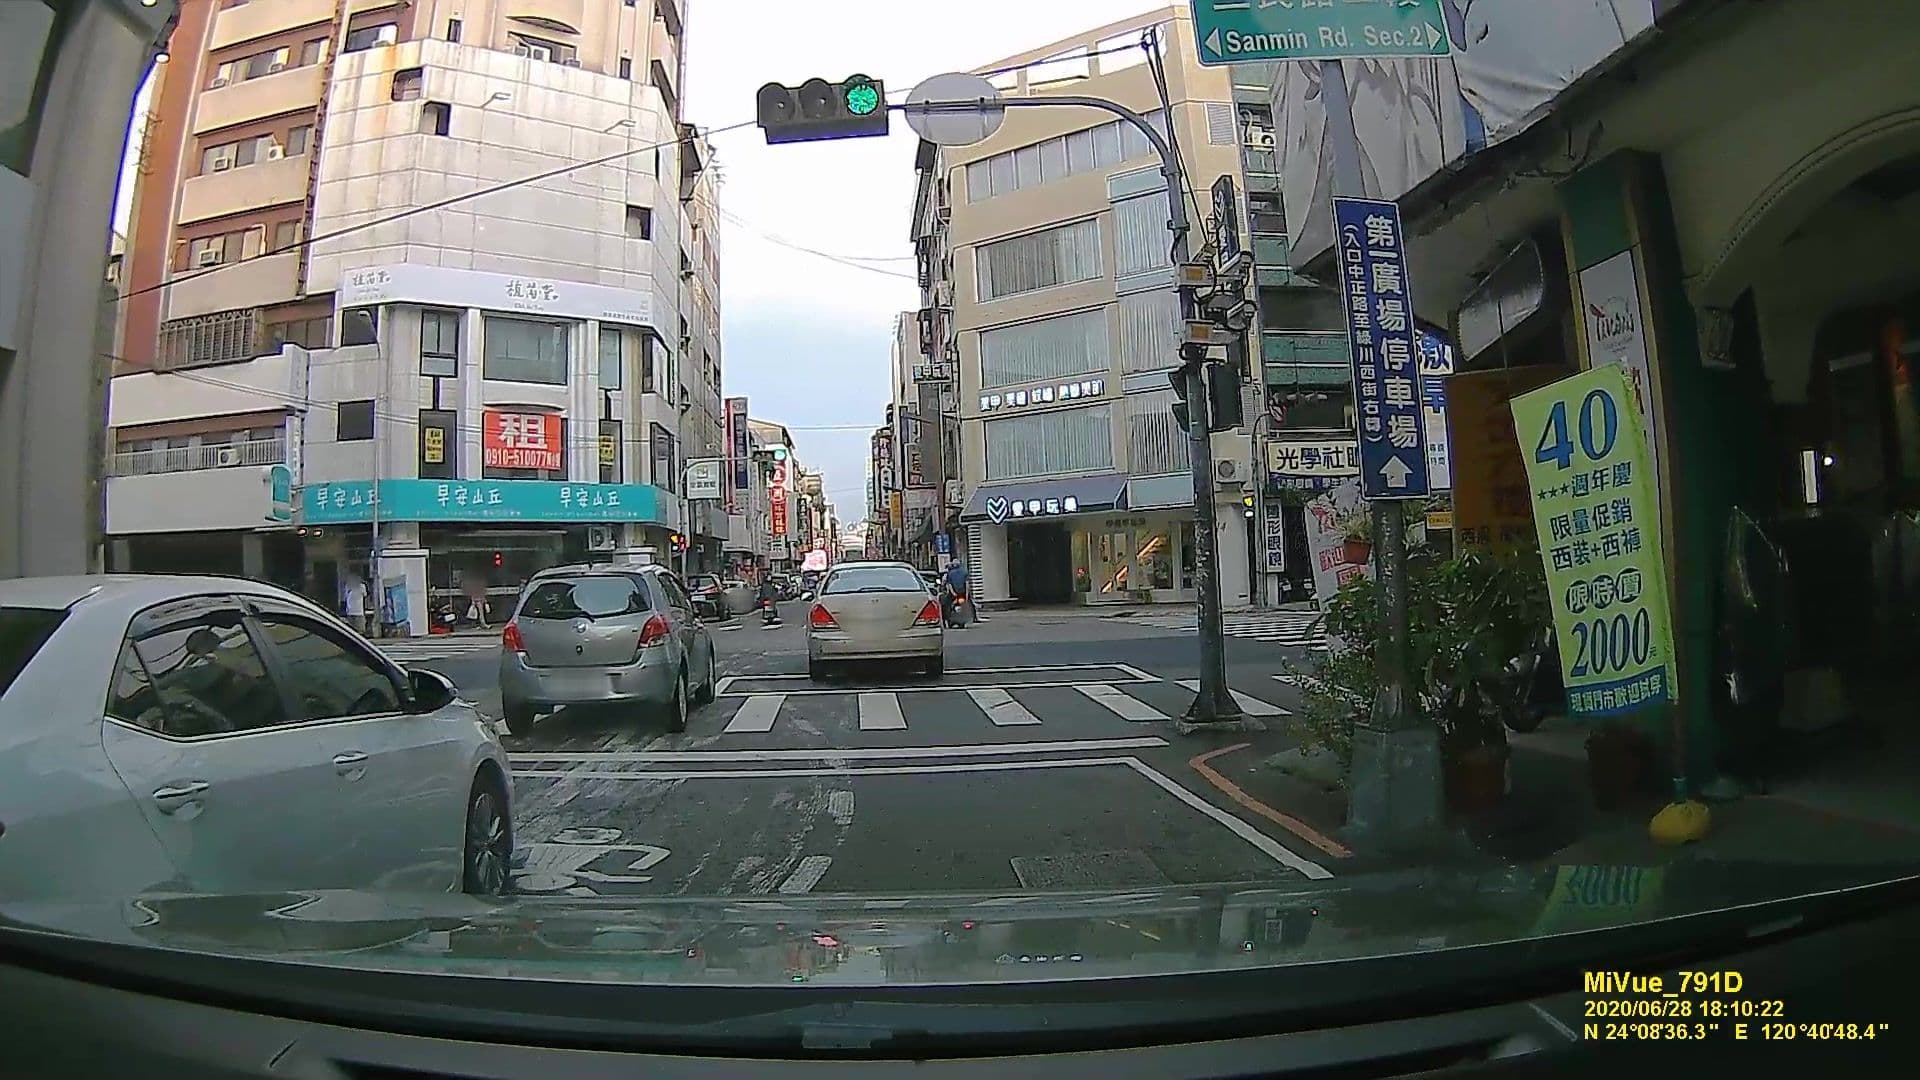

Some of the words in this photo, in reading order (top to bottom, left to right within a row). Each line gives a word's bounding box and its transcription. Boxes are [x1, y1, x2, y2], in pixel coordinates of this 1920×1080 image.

[1226, 28, 1307, 52] Sanmin
[1317, 27, 1353, 48] Rd.
[1364, 25, 1424, 47] Sec.2
[1365, 214, 1418, 449] 第一廣場停車場
[498, 413, 548, 450] 租
[1535, 388, 1618, 471] 40
[486, 447, 547, 466] 0910-510077
[438, 483, 504, 507] 早安山丘
[560, 486, 621, 508] 早安山丘
[1571, 461, 1632, 498] 週年慶
[315, 487, 381, 511] 早安山丘
[1550, 497, 1633, 541] 限量促銷
[1550, 527, 1642, 571] 西裝+西褲
[1566, 567, 1642, 614] 限時價
[1570, 607, 1650, 678] 2000
